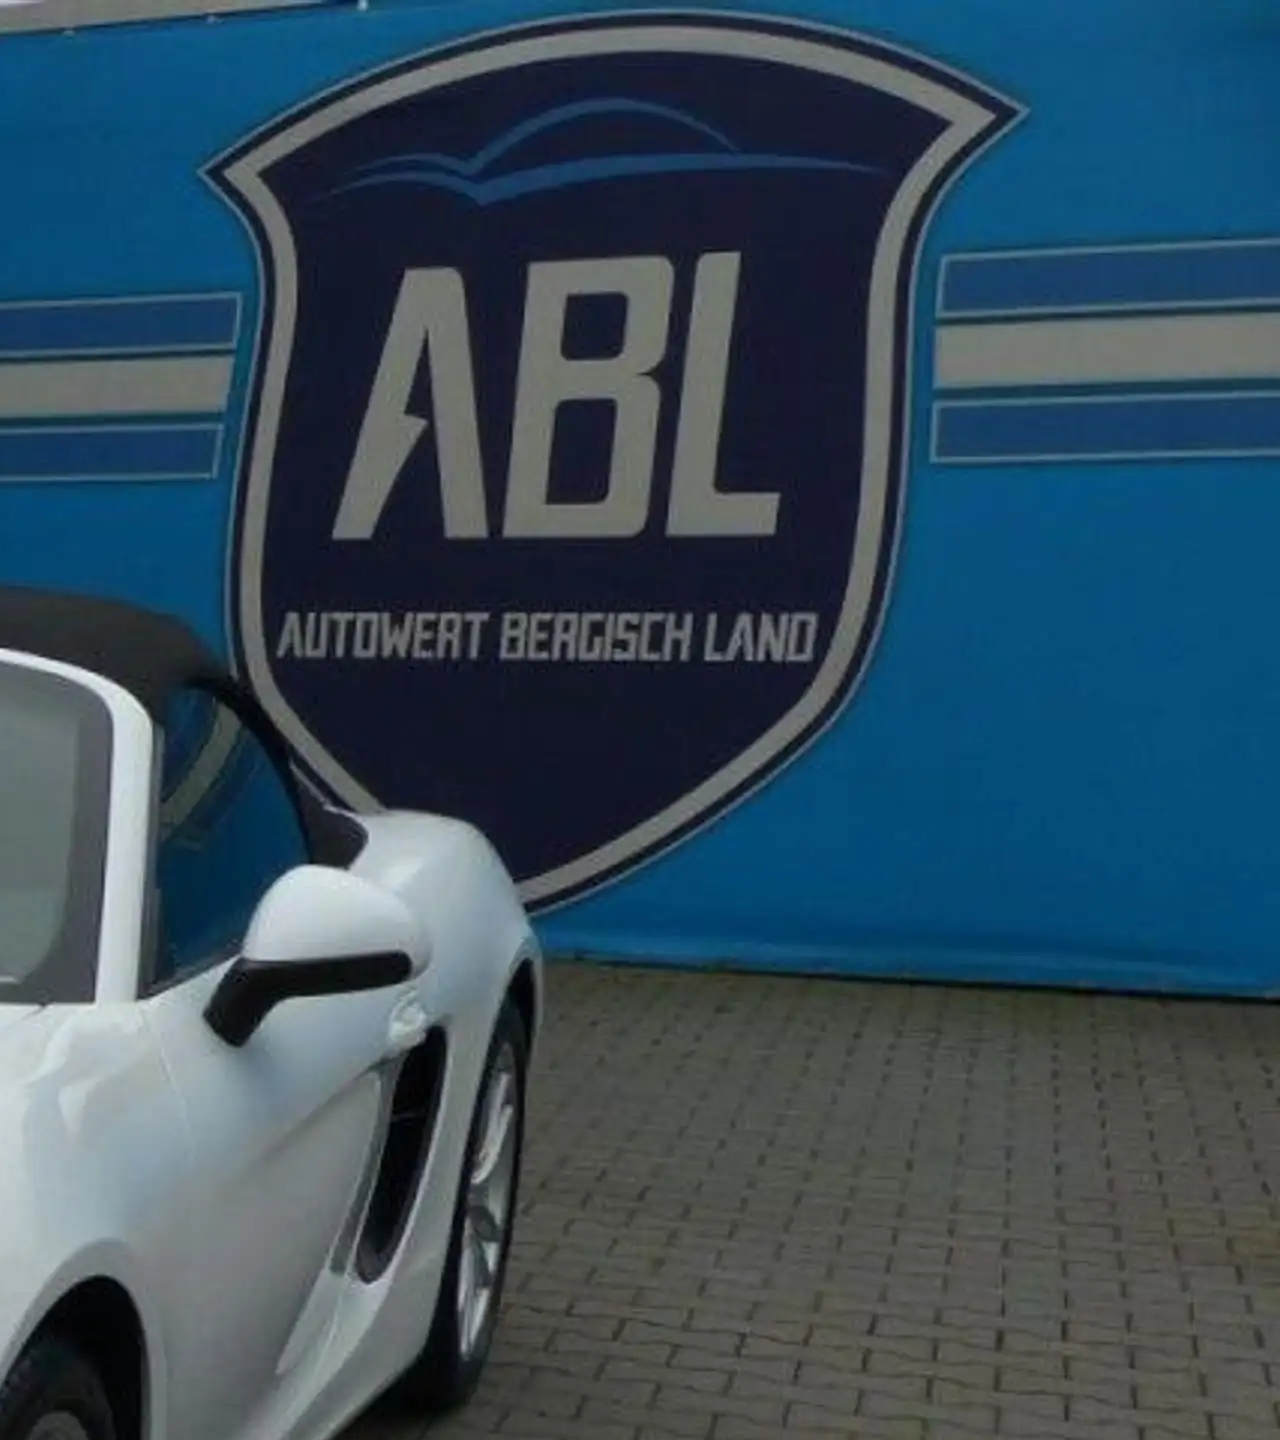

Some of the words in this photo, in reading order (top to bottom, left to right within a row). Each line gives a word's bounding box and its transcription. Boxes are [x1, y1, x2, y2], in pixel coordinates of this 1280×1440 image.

[332, 251, 781, 541] ABL
[277, 611, 488, 660] AUTOWERT
[499, 611, 692, 662] BERGISCH
[703, 611, 818, 663] LAND
